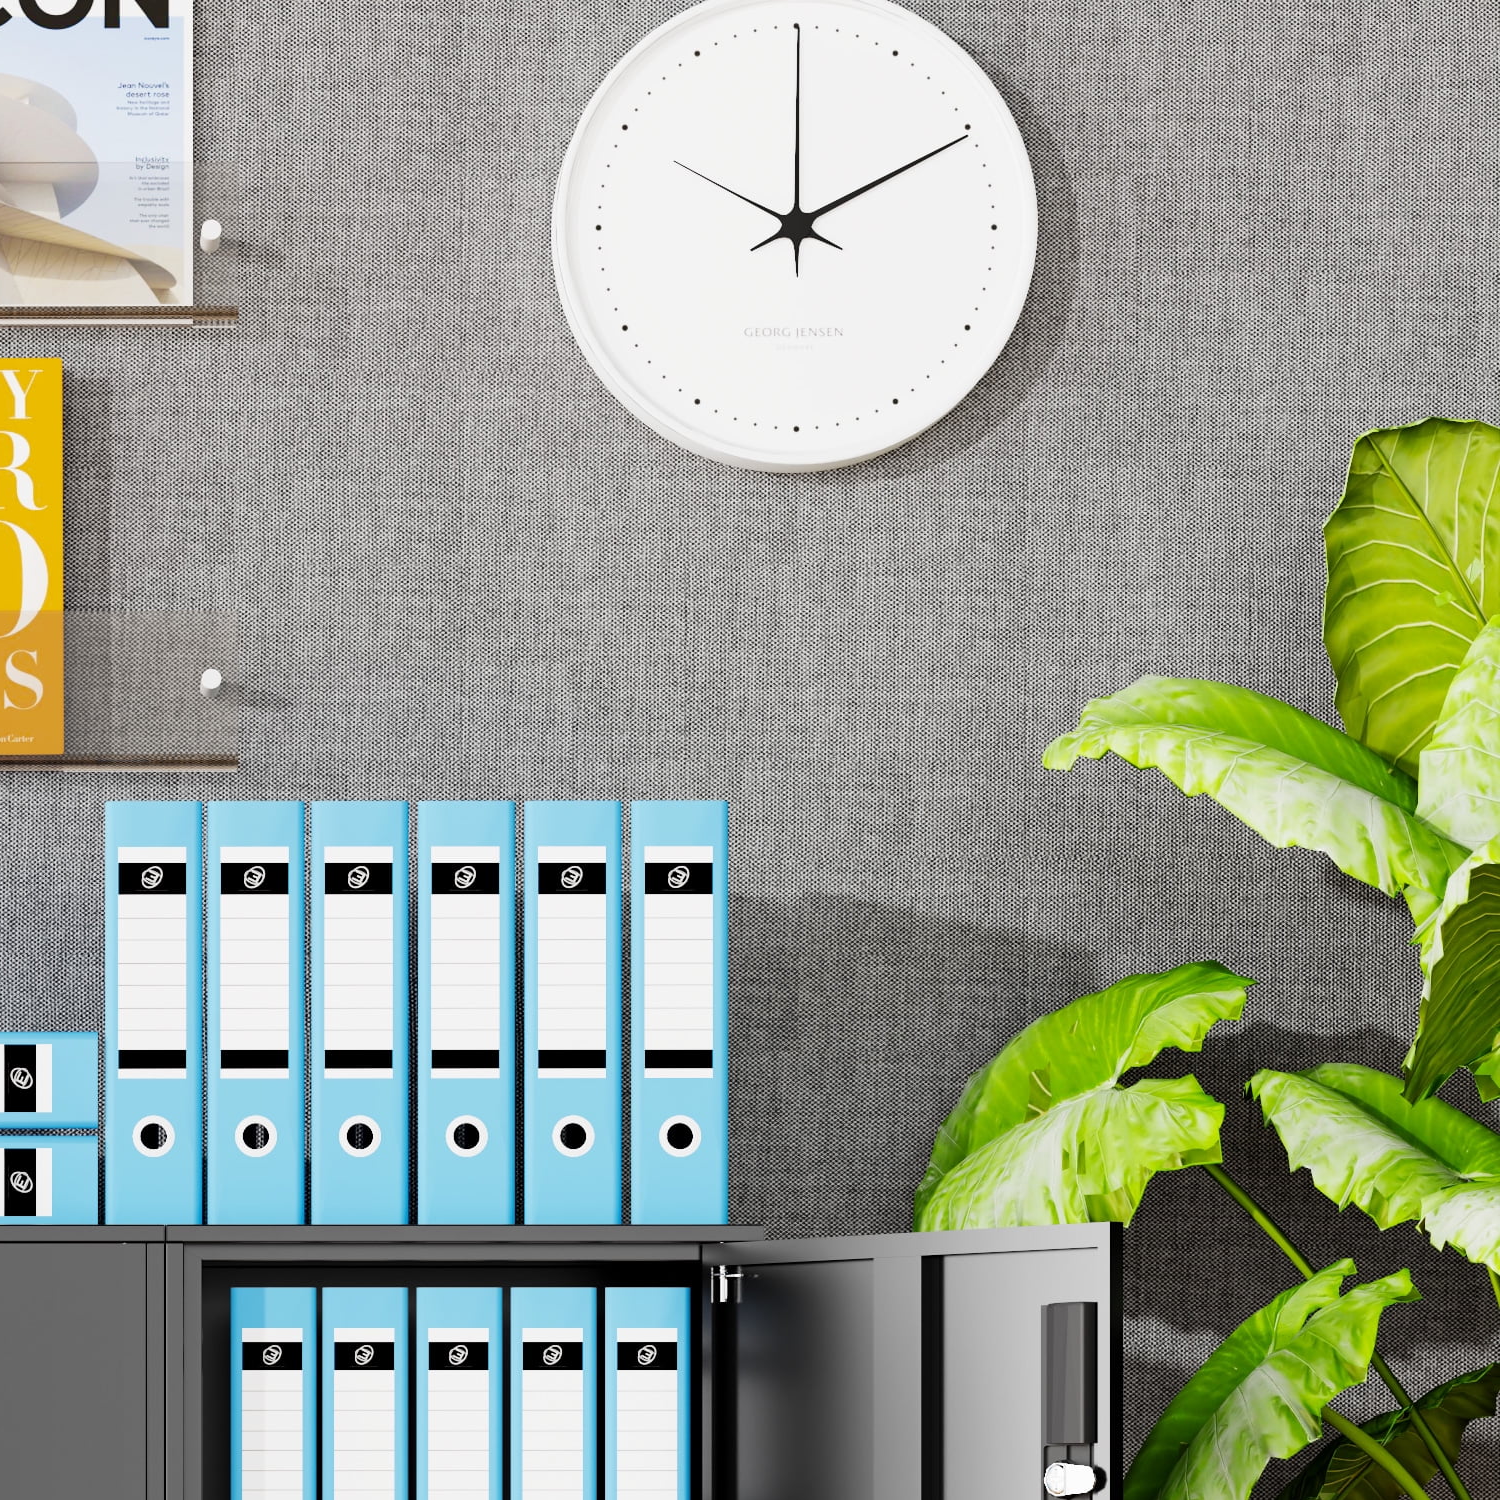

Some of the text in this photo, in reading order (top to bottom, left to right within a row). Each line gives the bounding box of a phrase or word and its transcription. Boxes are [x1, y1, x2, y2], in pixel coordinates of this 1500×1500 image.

[743, 327, 844, 338] GEORG JENSEN
[7, 734, 35, 743] Carter
